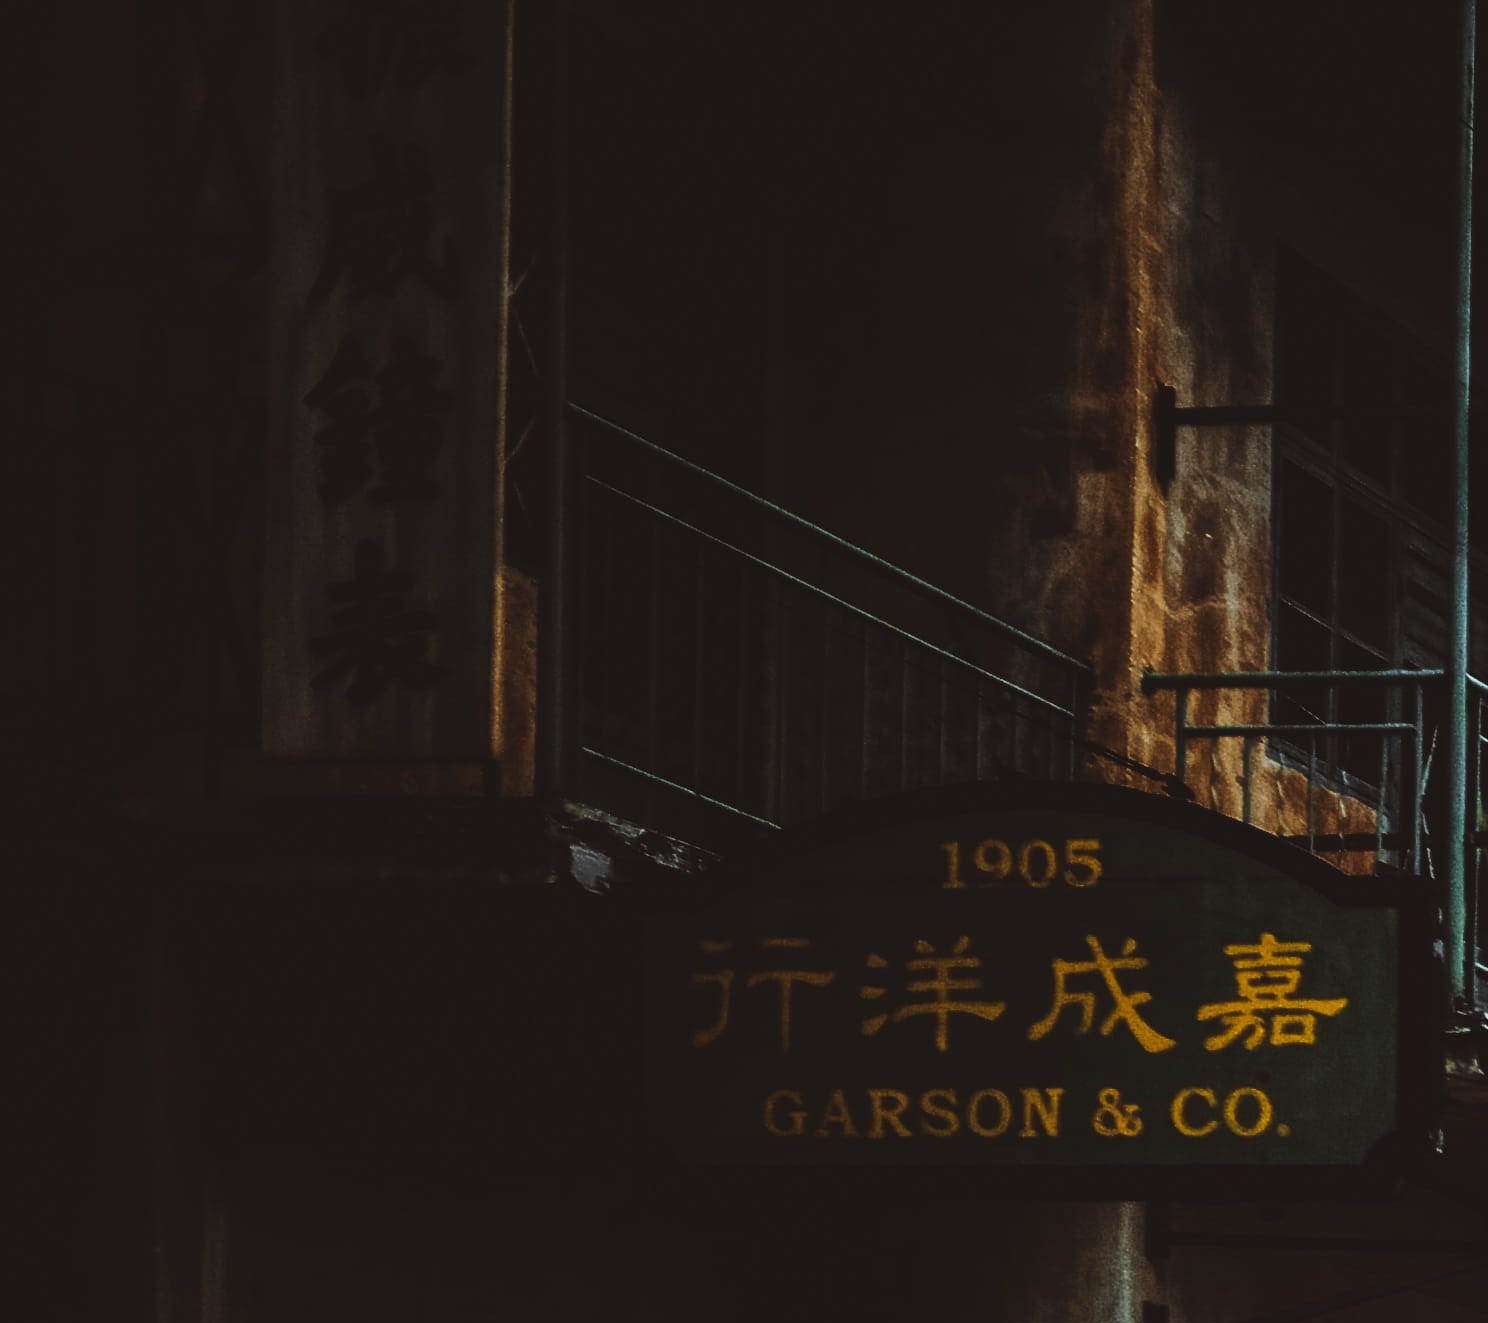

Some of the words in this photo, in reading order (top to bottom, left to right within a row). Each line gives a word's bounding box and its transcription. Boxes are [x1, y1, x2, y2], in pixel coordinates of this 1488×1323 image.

[939, 837, 1105, 889] 1905
[763, 1086, 1065, 1138] GARSON
[1092, 1086, 1143, 1138] &
[1170, 1085, 1292, 1139] CO.
